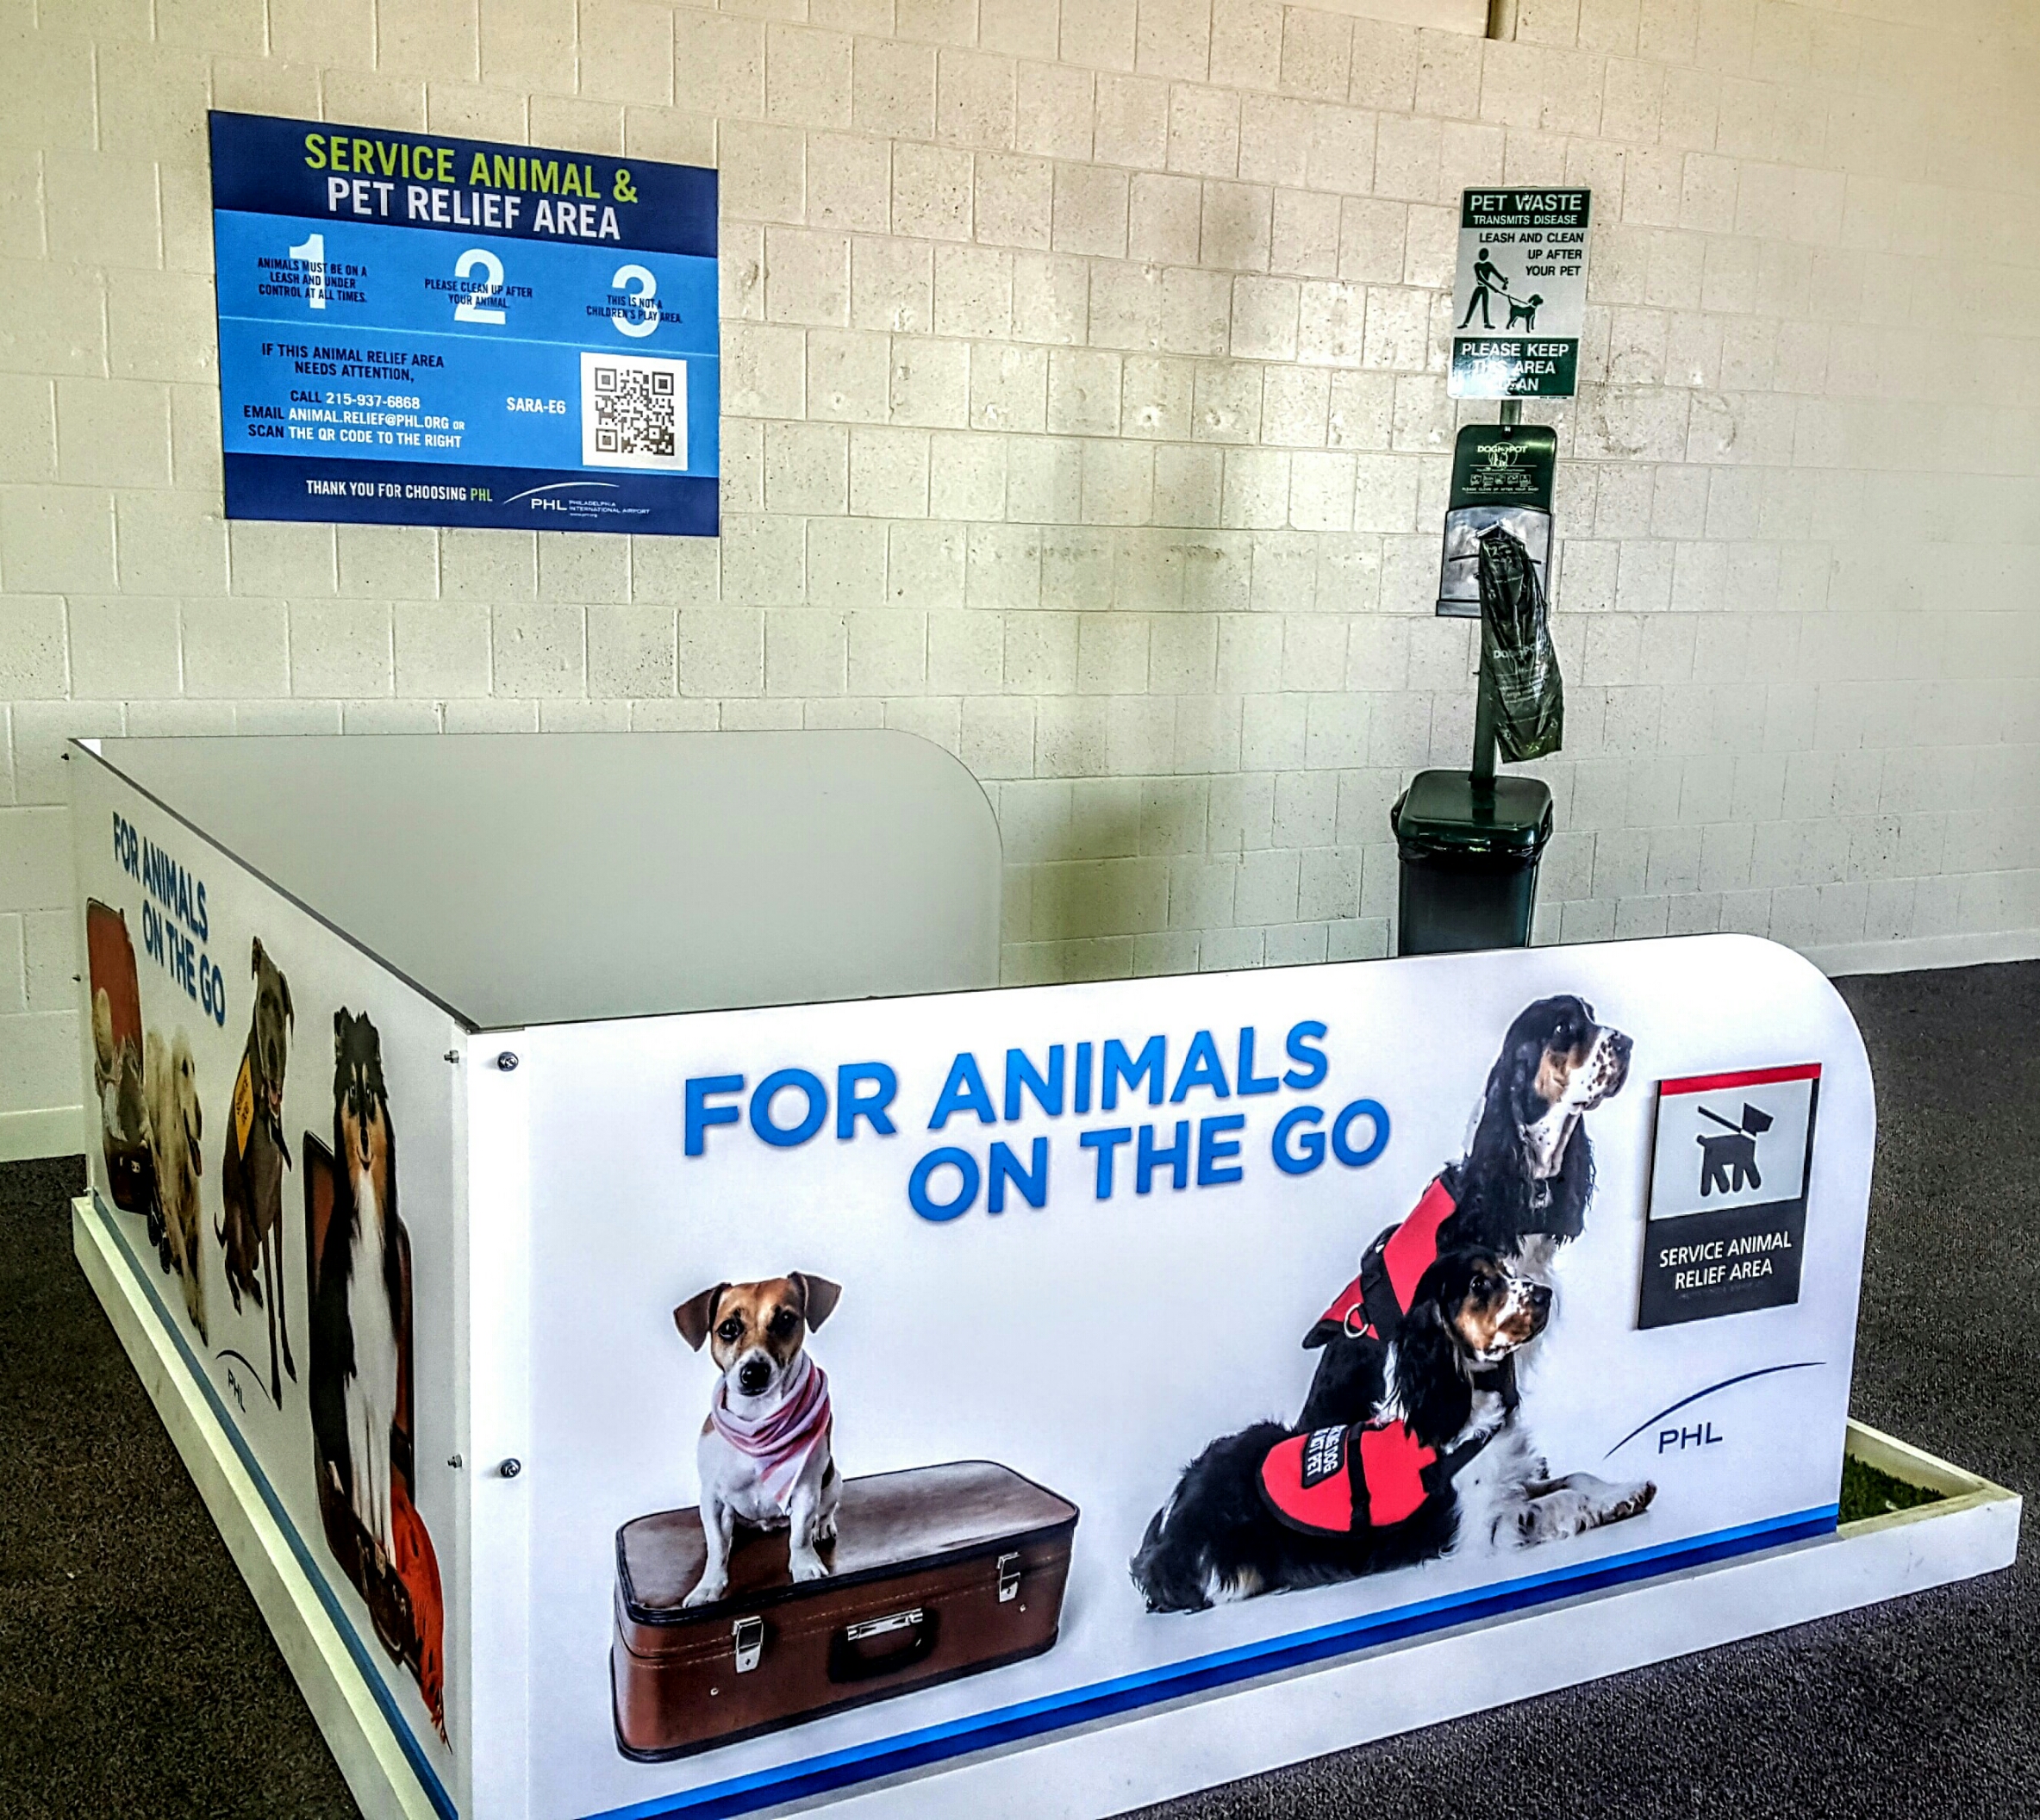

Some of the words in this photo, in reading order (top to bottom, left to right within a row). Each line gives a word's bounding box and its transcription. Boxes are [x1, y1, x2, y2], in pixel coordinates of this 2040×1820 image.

[303, 133, 456, 184] SERVICE
[468, 152, 602, 200] ANIMAL
[612, 168, 639, 203] &
[327, 176, 395, 216] PET
[407, 184, 522, 229] RELIEF
[533, 198, 621, 240] AREA
[1469, 194, 1508, 212] PET
[1515, 193, 1582, 212] WASTE
[1472, 215, 1531, 226] TRANSMITS
[1533, 215, 1578, 225] DISEASE
[1479, 233, 1515, 244] LEASH
[1519, 233, 1543, 243] AND
[1546, 232, 1584, 243] CLEAN
[1527, 249, 1543, 259] UP
[1546, 249, 1582, 259] AFTER
[258, 257, 300, 271] ANIMALS
[302, 260, 327, 273] MUST
[330, 263, 343, 275] BE
[345, 265, 359, 276] ON
[360, 266, 368, 277] A
[289, 233, 326, 309] 1
[1525, 265, 1556, 276] YOUR
[1560, 265, 1581, 276] PET
[270, 271, 300, 284] LEASH
[302, 275, 321, 286] AND
[325, 277, 356, 289] UNDER
[424, 277, 458, 292] PLEASE
[460, 282, 489, 295] CLEAN
[491, 284, 503, 295] UP
[505, 285, 533, 298] AFTER
[454, 248, 506, 325] 2
[258, 284, 302, 298] CONTROL
[304, 288, 315, 298] AT
[318, 289, 335, 301] ALL
[336, 290, 368, 302] TIMES.
[448, 294, 472, 306] YOUR
[607, 294, 627, 306] THIS
[628, 296, 637, 308] IS
[639, 297, 656, 309] NOT
[657, 299, 664, 310] A
[612, 264, 660, 338] 3
[586, 305, 636, 320] CHILDREN'S
[638, 310, 658, 321] PLAY
[261, 342, 274, 356] IF
[277, 344, 308, 358] THIS
[313, 346, 363, 363] ANIMAL
[366, 350, 409, 365] RELIEF
[411, 353, 445, 369] AREA
[1461, 343, 1521, 357] PLEASE
[1526, 344, 1569, 357] KEEP
[294, 360, 337, 377] NEEDS
[340, 364, 415, 383] ATTENTION,
[1514, 361, 1557, 375] AREA
[290, 390, 322, 404] CALL
[325, 392, 421, 410] 215-937-6868
[506, 396, 566, 414] SARA-E6
[243, 404, 285, 420] EMAIL
[288, 407, 450, 430] ANIMAL.RELIEF@PHL.ORG
[452, 420, 466, 431] OR
[247, 424, 284, 439] SCAN
[288, 426, 314, 440] THE
[317, 427, 336, 442] QR
[339, 429, 373, 444] CODE
[377, 431, 394, 445] TO
[396, 432, 421, 446] THE
[424, 434, 462, 449] RIGHT
[306, 479, 347, 496] THANK
[349, 481, 374, 497] YOU
[377, 483, 402, 498] FOR
[405, 483, 467, 502] CHOOSING
[470, 487, 493, 502] PHL
[531, 498, 568, 511] PHL
[112, 810, 140, 883] FOR
[142, 835, 209, 945] ANIMALS
[142, 899, 165, 968] ON
[165, 919, 197, 1002] THE
[199, 953, 226, 1028] GO
[683, 1060, 899, 1157] FOR
[926, 1019, 1330, 1131] ANIMALS
[908, 1135, 1049, 1223] ON
[1079, 1113, 1245, 1201] THE
[1270, 1098, 1391, 1176] GO
[1659, 1241, 1724, 1268] SERVICE
[1726, 1230, 1793, 1257] ANIMAL
[1675, 1263, 1727, 1291] RELIEF
[1729, 1257, 1774, 1281] AREA
[228, 1367, 246, 1413] PHL
[1658, 1421, 1724, 1455] PHL
[1307, 1451, 1323, 1478] PET
[1323, 1444, 1338, 1474] DOG
